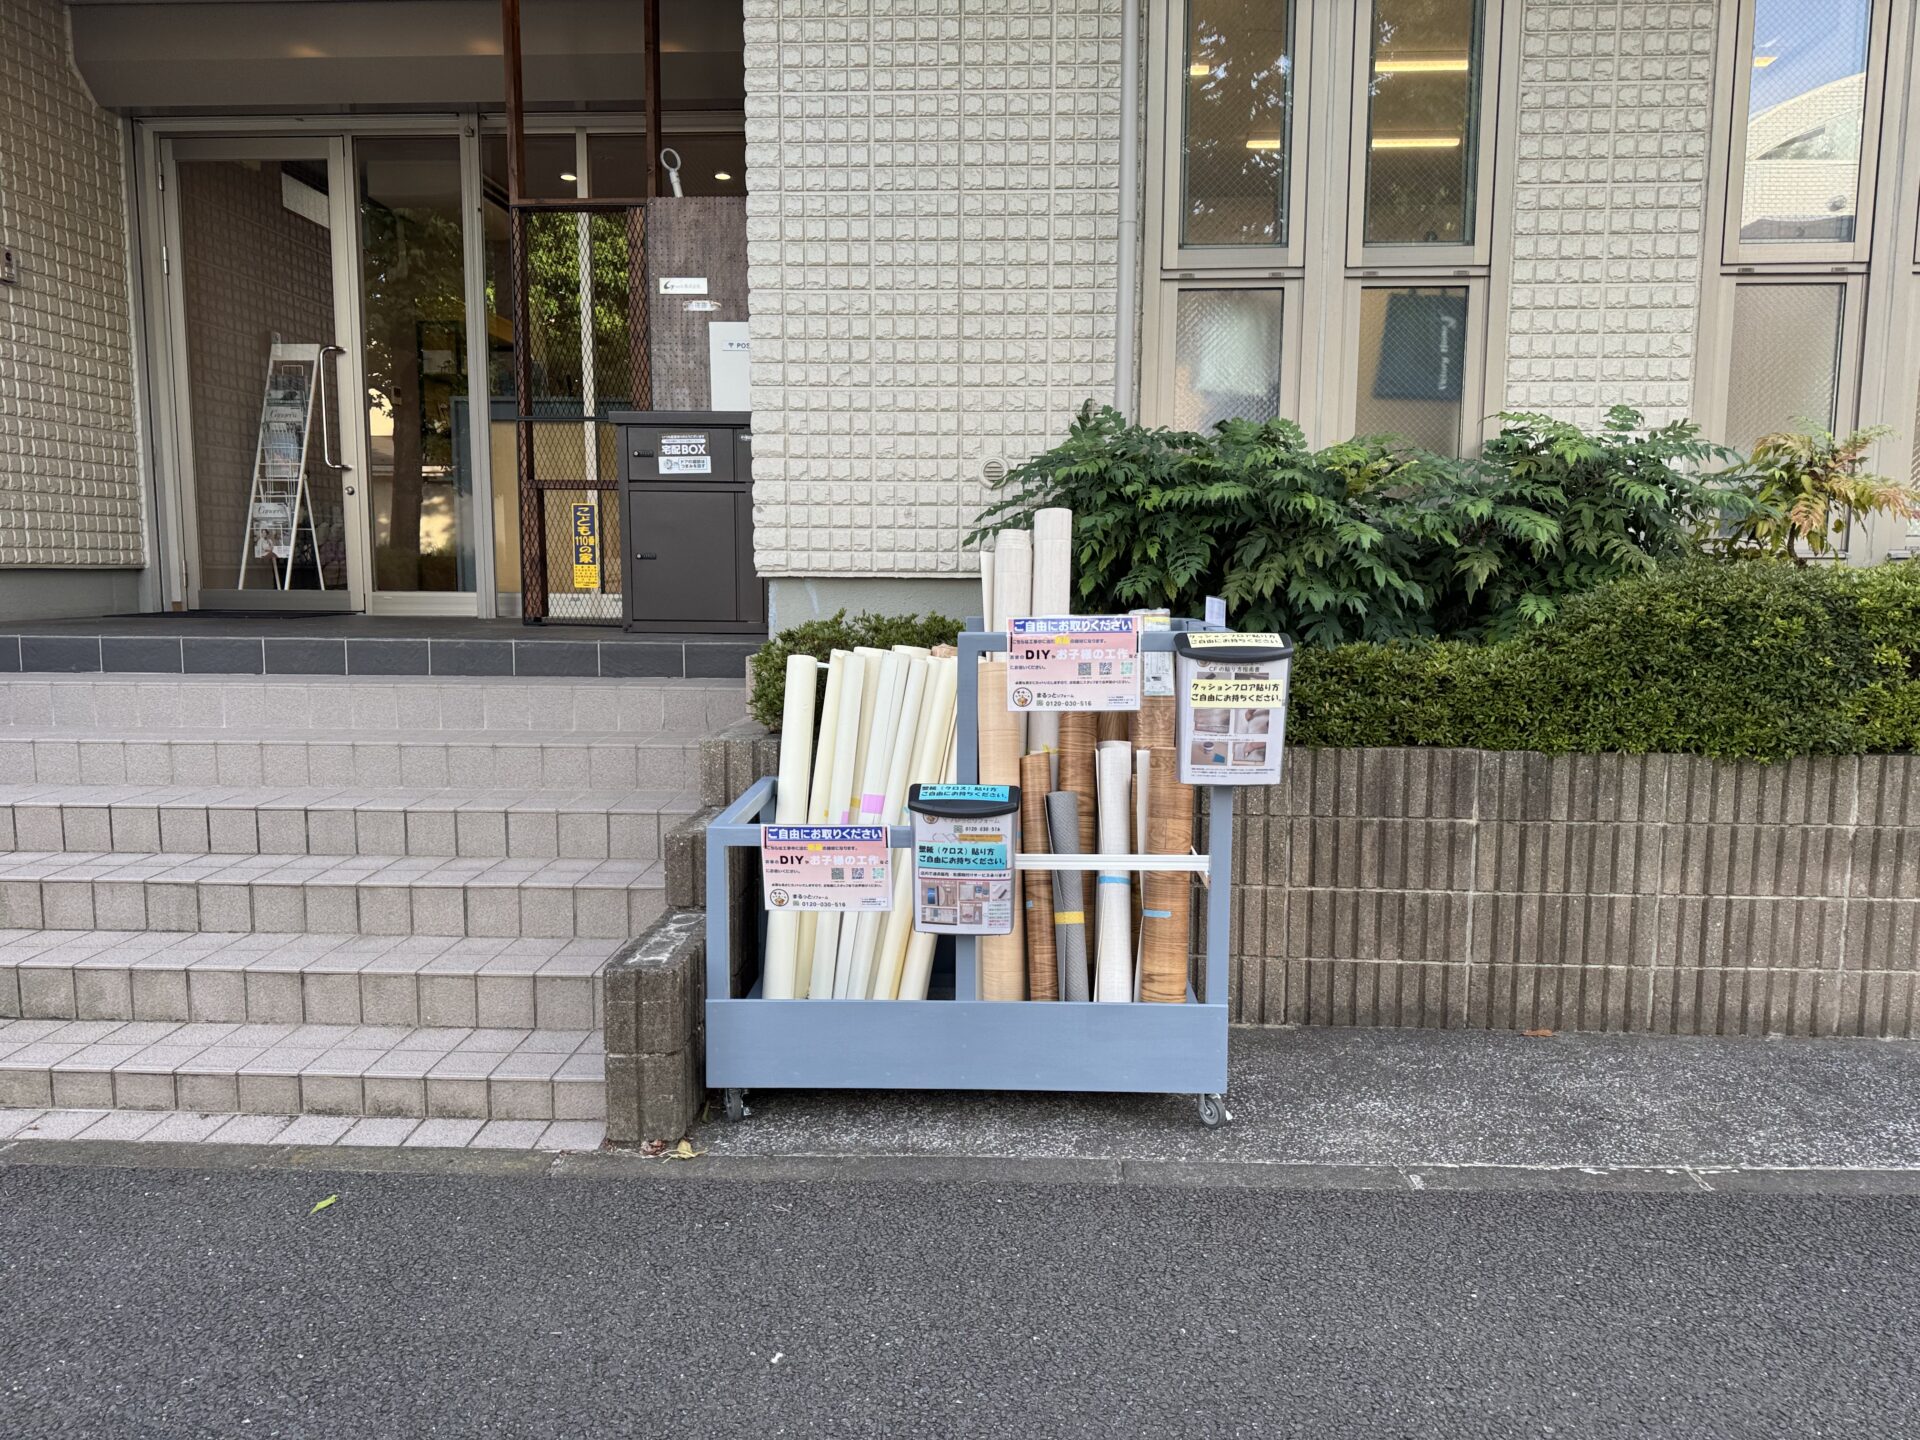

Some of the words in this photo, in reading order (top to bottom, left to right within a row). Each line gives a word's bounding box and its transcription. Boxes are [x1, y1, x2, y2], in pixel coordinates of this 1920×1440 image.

[661, 444, 706, 455] 宅配BOX
[575, 508, 594, 562] こども110番の家
[1014, 619, 1132, 633] ご自由にお取りください
[1191, 682, 1279, 692] クッションフロア貼り方
[1191, 693, 1282, 703] ご自由にお持ちください。
[920, 791, 1008, 799] ご自由にお持ちください。
[768, 828, 882, 840] ご自由にお取りください
[919, 855, 1005, 865] ご自由にお持ちください。
